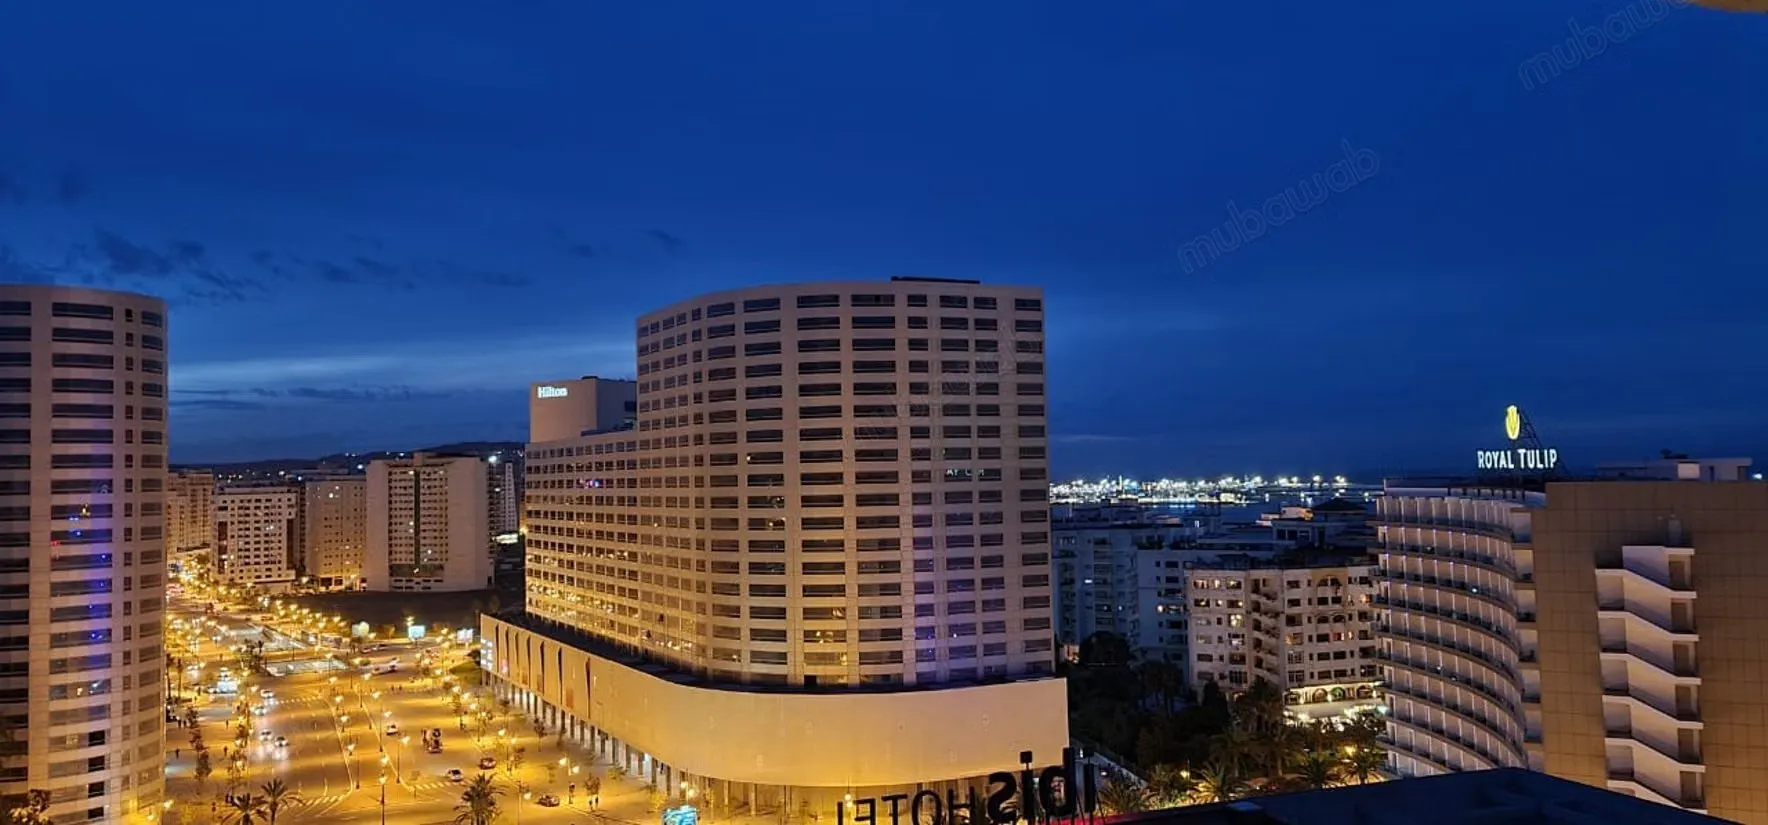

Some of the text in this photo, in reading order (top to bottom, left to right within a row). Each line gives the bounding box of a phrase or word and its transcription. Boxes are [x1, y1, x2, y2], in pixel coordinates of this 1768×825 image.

[537, 386, 568, 398] Hilton
[1477, 448, 1557, 468] ROYAL TULIP
